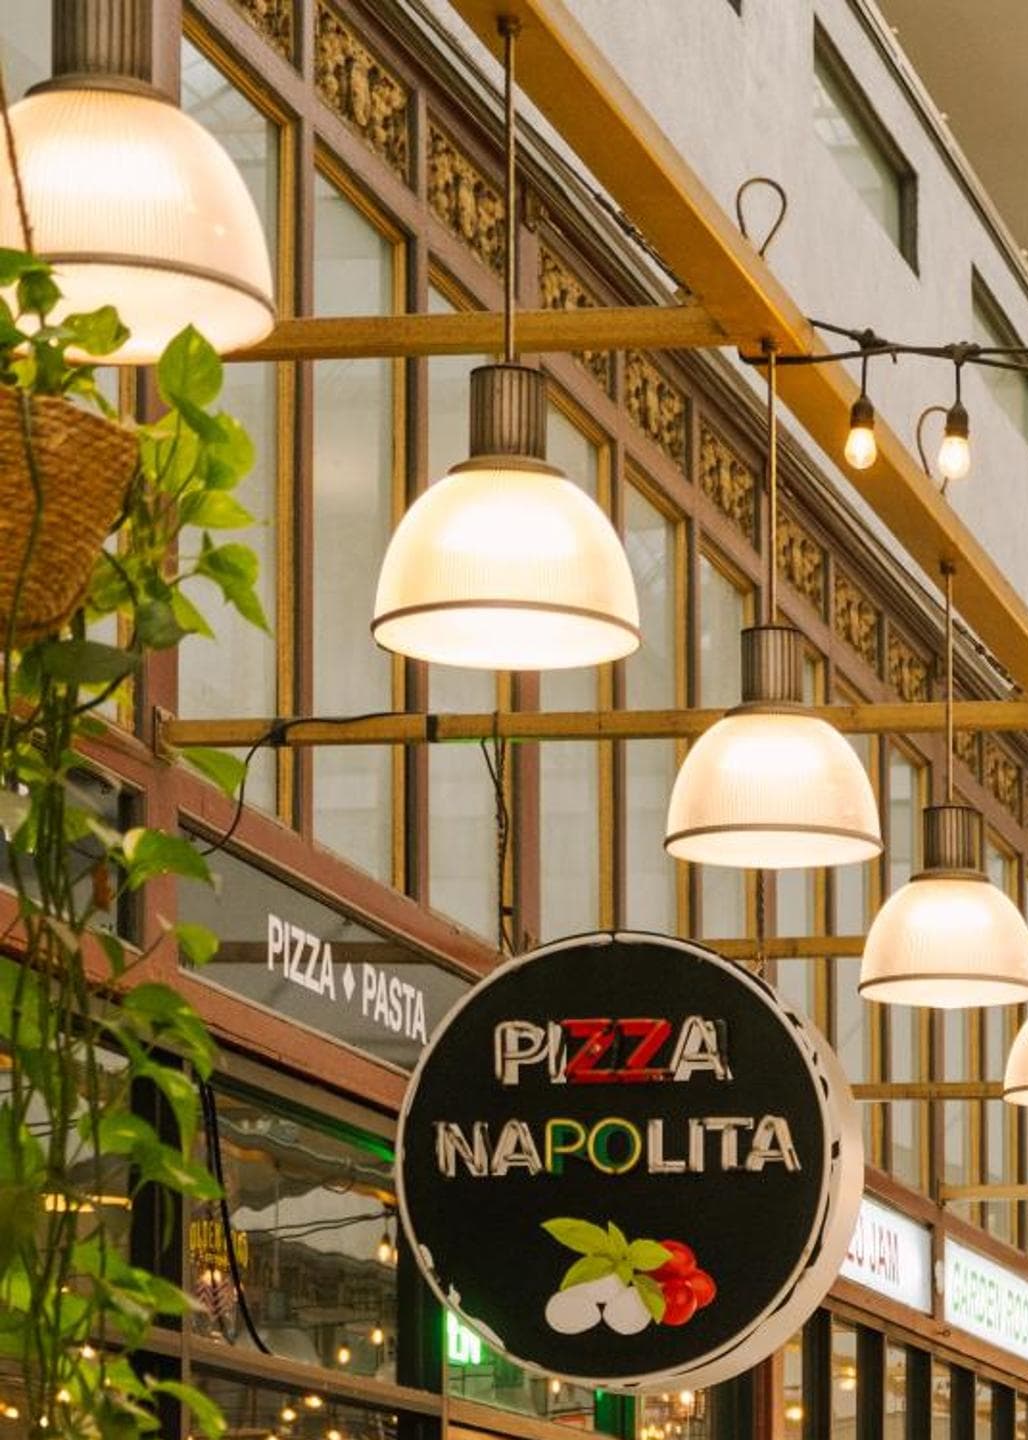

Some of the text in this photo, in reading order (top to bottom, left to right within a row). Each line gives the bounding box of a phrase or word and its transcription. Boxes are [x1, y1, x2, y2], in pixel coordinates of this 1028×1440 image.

[267, 913, 428, 1046] PIZZA PASTA
[494, 1015, 733, 1085] PIZZA
[433, 1114, 801, 1177] NAPOLITA
